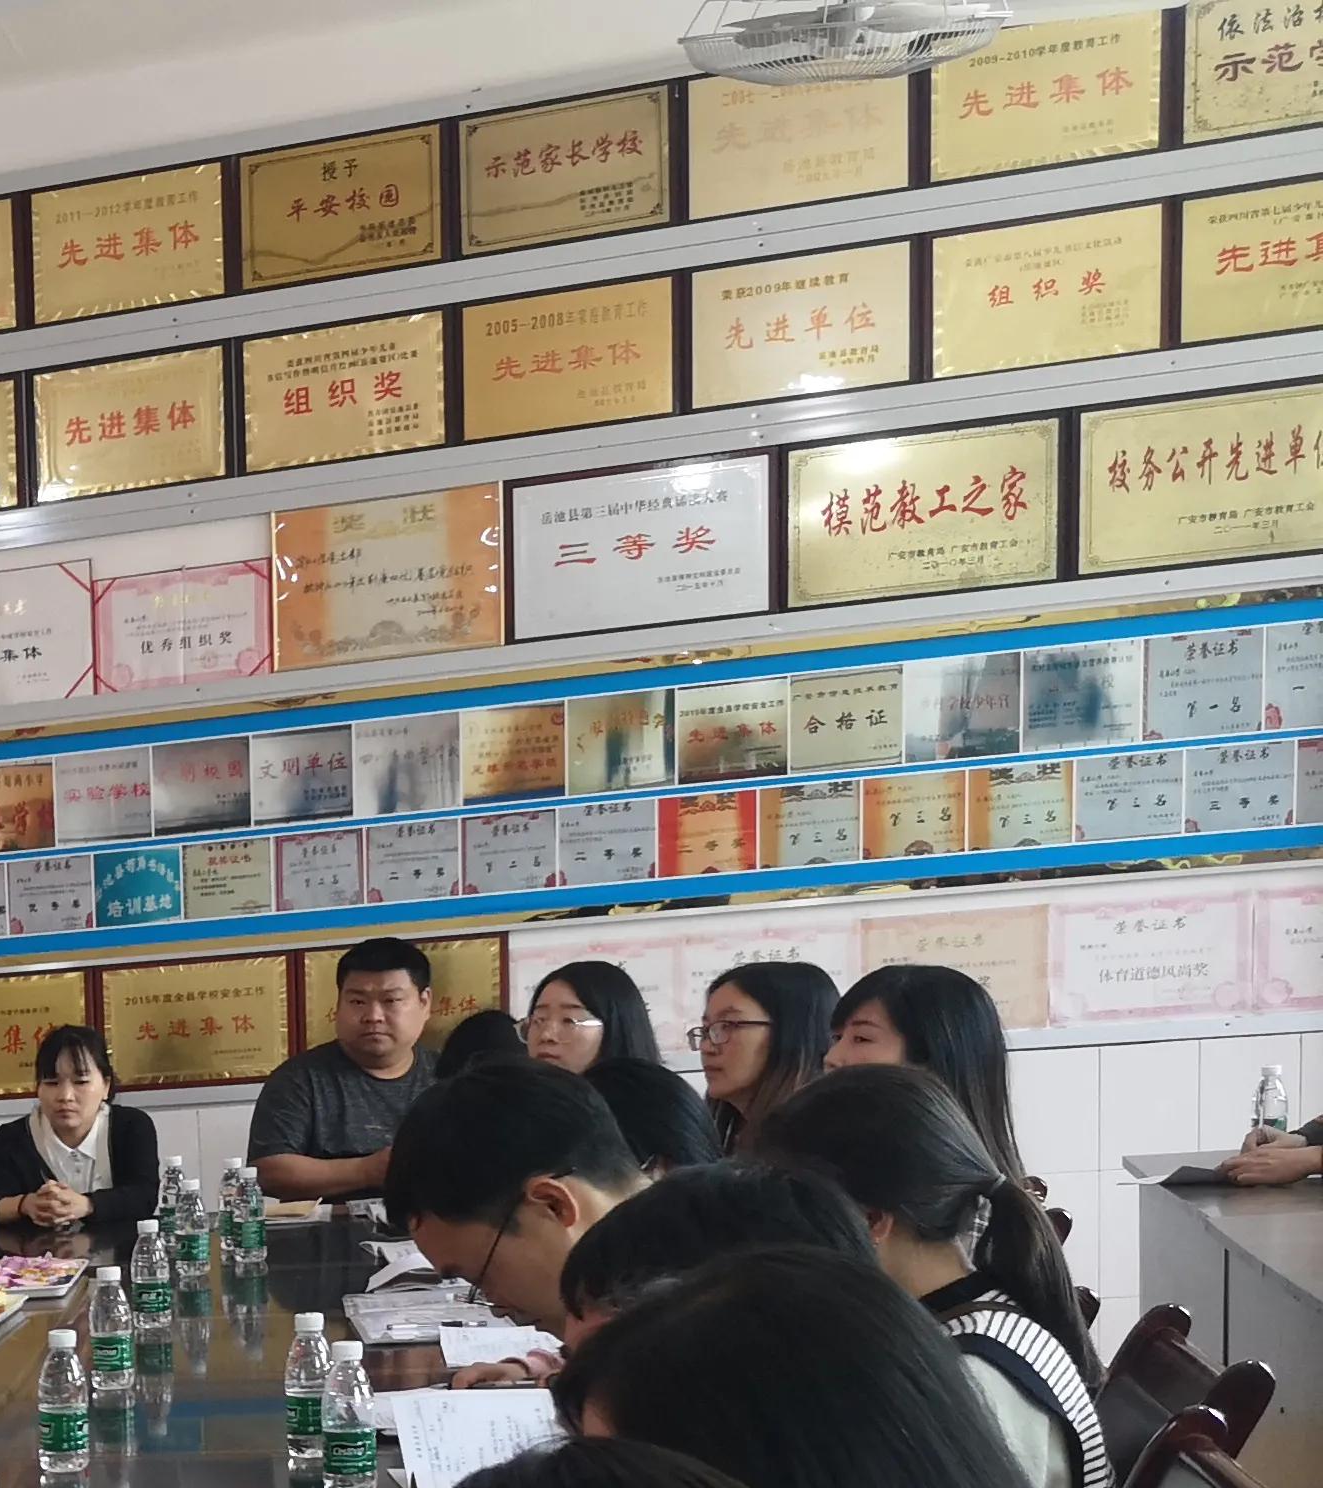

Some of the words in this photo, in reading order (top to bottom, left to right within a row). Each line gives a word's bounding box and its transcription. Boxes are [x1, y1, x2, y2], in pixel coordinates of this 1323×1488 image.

[959, 66, 1134, 120] 先进集体
[322, 158, 359, 182] 授予
[484, 129, 643, 178] 示范家长学校
[286, 183, 400, 224] 平安校园
[57, 220, 199, 269] 先进集体
[988, 268, 1106, 308] 组织奖
[724, 301, 876, 350] 先进单位
[491, 339, 641, 381] 先进集体
[283, 370, 403, 415] 组织奖
[65, 400, 196, 447] 先进集体
[820, 465, 1028, 537] 模范教工之家
[555, 525, 716, 567] 三等奖
[140, 631, 232, 654] 优秀组织奖
[1186, 639, 1239, 661] 荣誉证书
[804, 708, 888, 735] 合格证
[258, 752, 349, 781] 文明单位
[107, 894, 173, 918] 培训基地
[1114, 916, 1187, 935] 荣誉证书
[1099, 963, 1209, 983] 体育道德风尚奖
[136, 1014, 256, 1042] 先进集体
